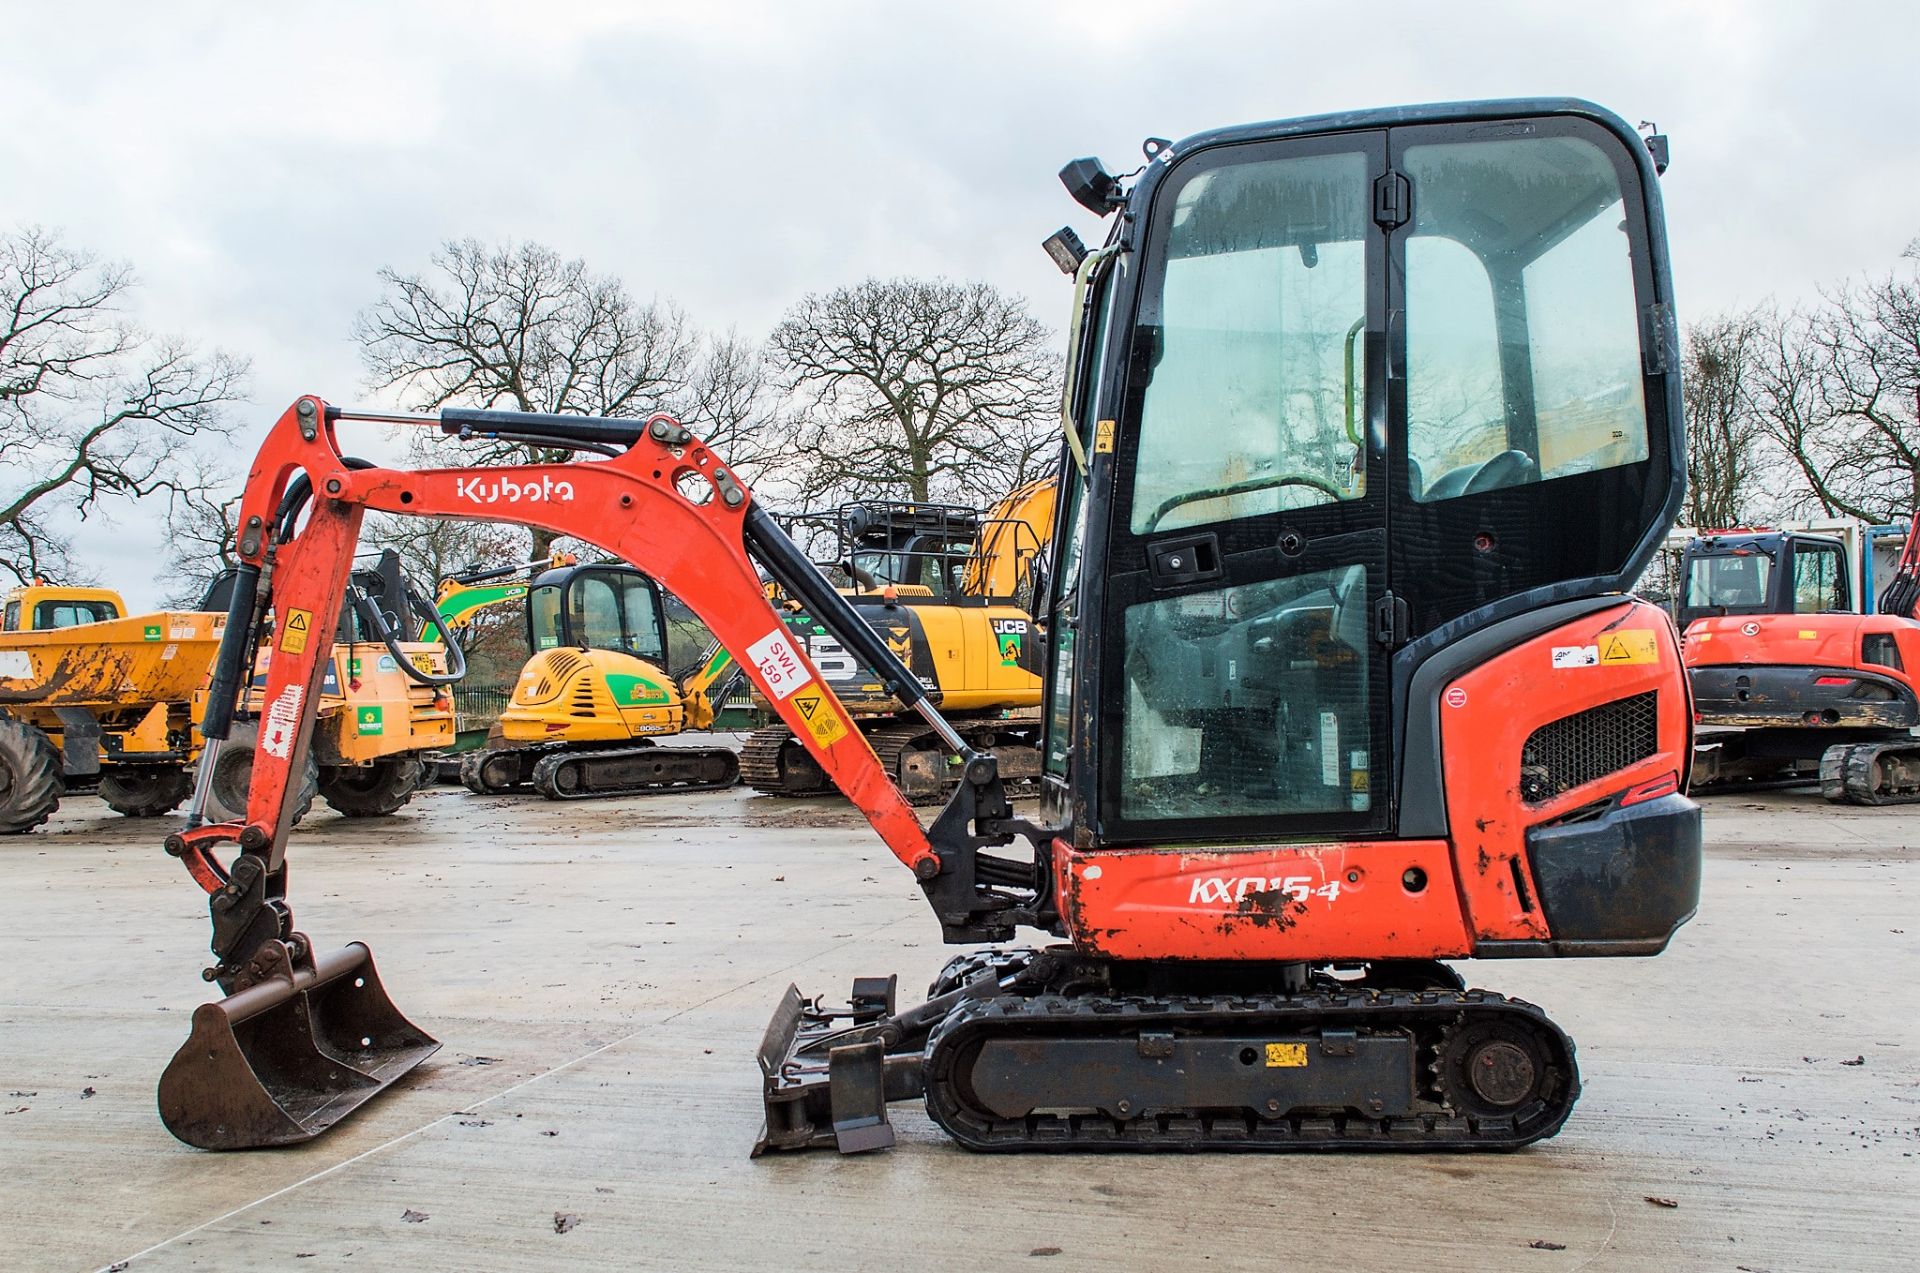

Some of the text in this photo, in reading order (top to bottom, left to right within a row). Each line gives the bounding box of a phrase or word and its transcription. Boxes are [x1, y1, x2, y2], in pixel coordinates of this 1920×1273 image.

[457, 475, 574, 503] Kubota
[993, 620, 1028, 634] JCB
[760, 656, 782, 684] 159
[770, 642, 797, 680] SWL
